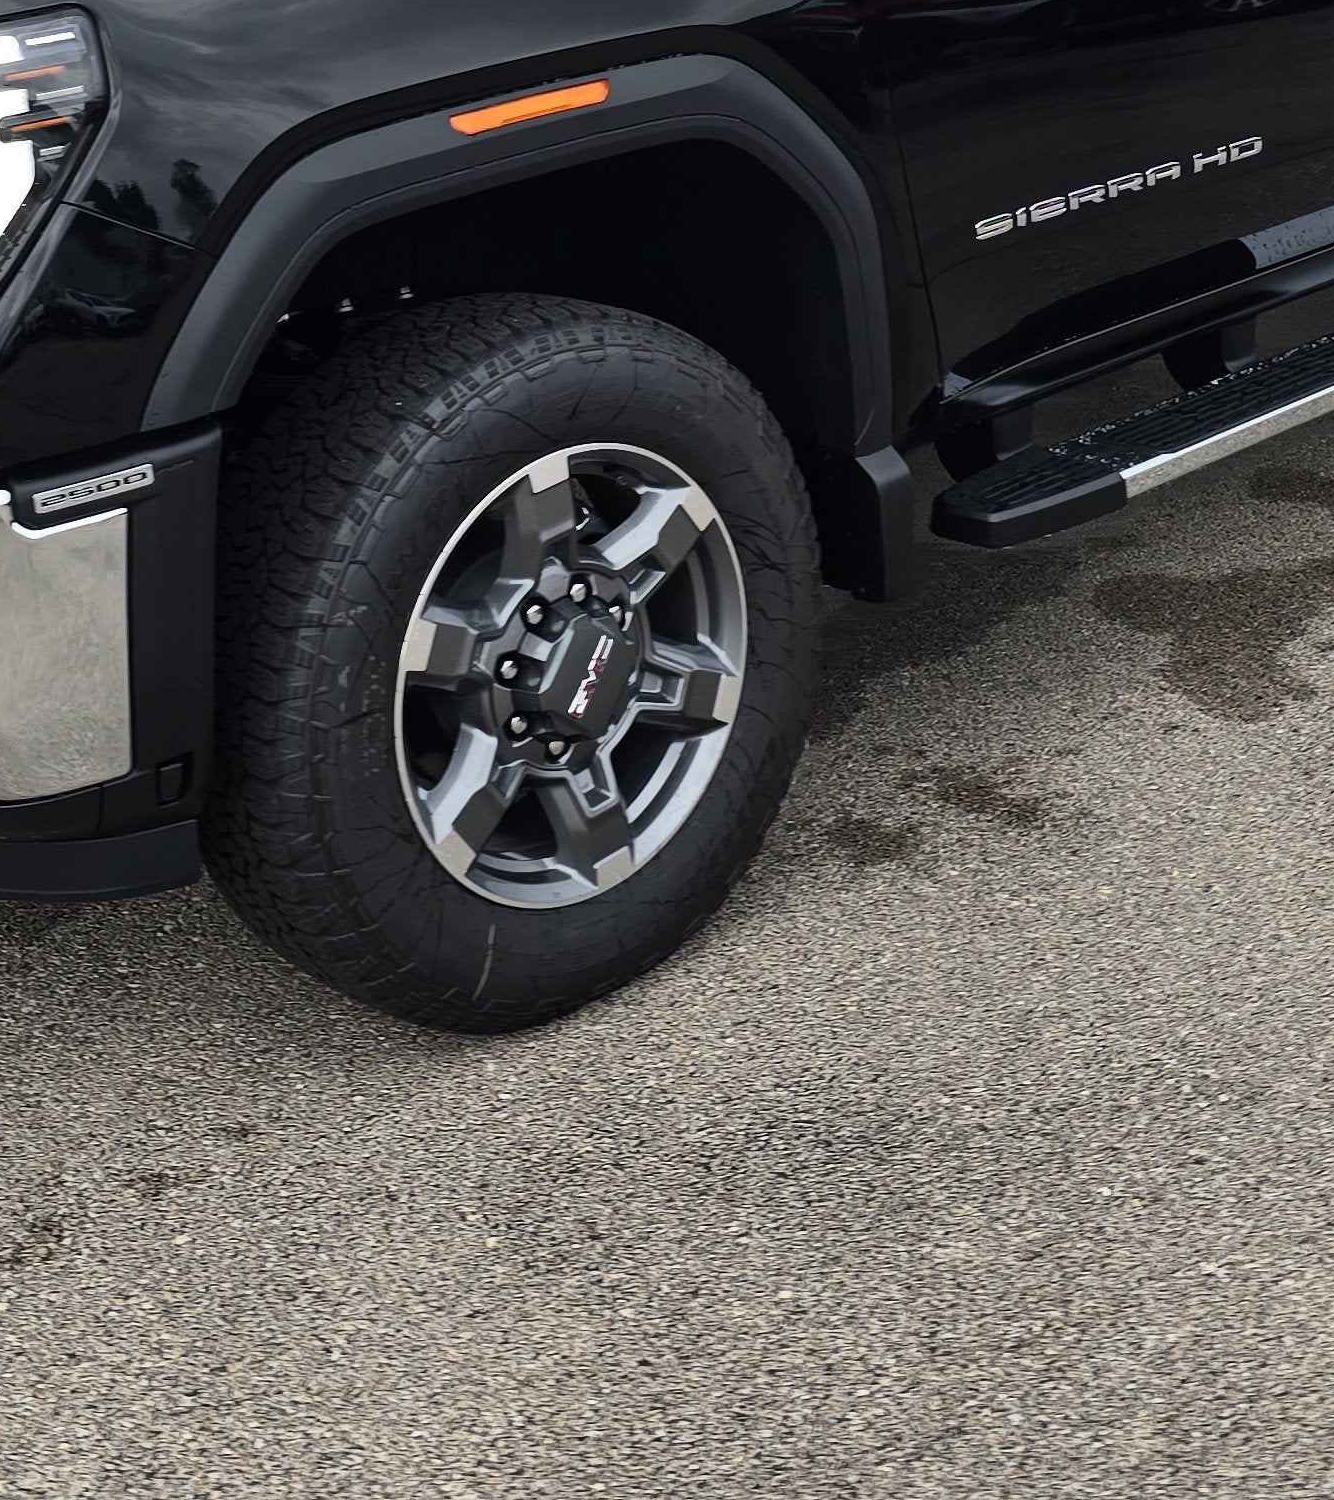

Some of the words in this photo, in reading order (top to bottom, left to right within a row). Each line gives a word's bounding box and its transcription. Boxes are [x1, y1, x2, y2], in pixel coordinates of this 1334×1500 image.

[974, 160, 1182, 241] SIERRA
[1192, 136, 1264, 174] HD
[39, 471, 147, 508] 2500
